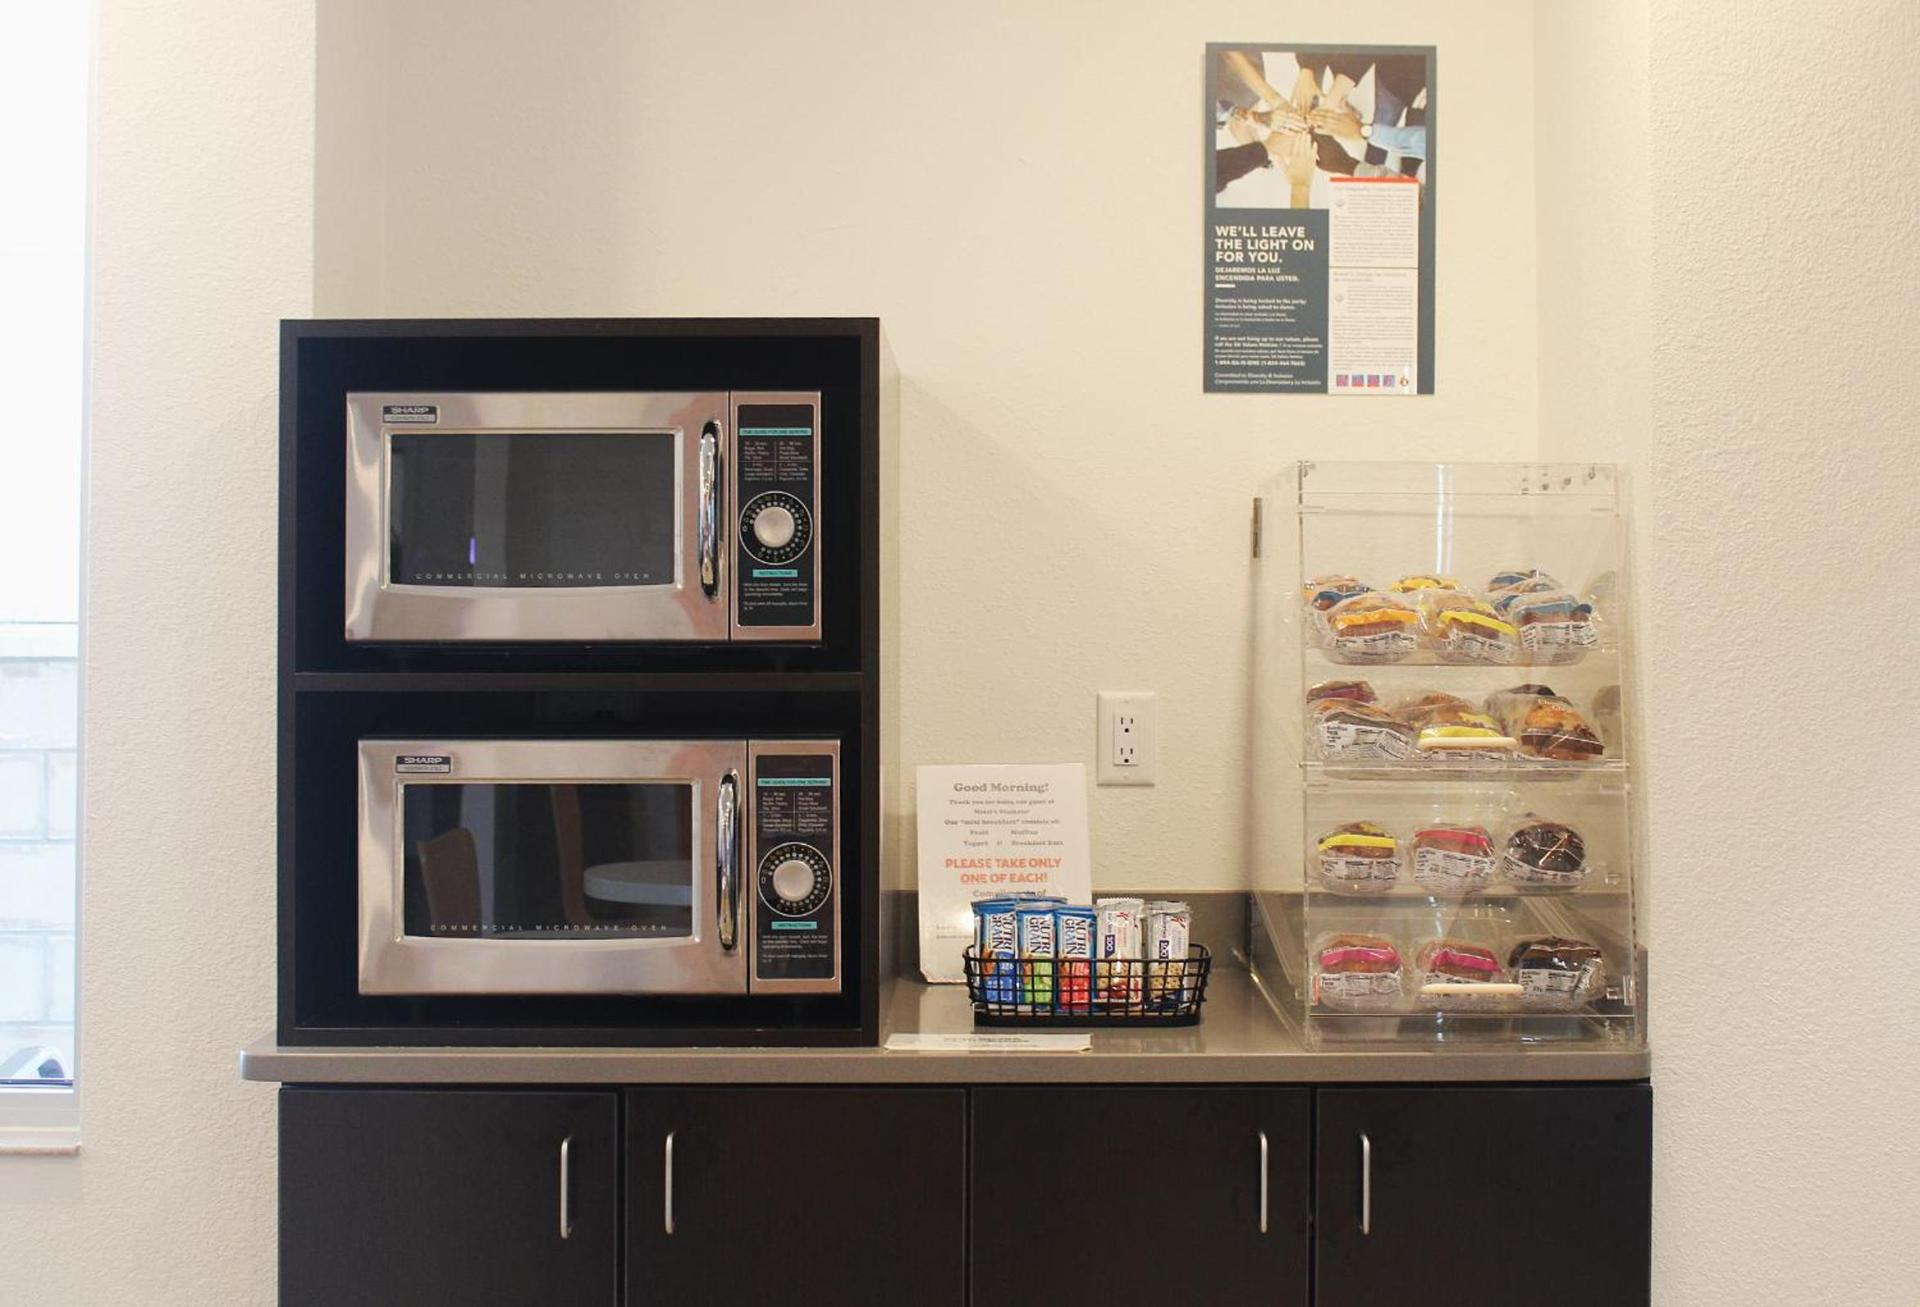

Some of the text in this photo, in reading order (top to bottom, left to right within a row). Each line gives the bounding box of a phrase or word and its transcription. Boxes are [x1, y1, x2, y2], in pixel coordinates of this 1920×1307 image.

[1215, 225, 1305, 238] WE'LL LEAVE
[1215, 239, 1314, 251] THE LIGHT ON
[1215, 251, 1283, 263] FOR YOU.
[953, 783, 1049, 794] Good Morning!
[945, 857, 1062, 869] PLEASE TAKE ONLY
[960, 872, 1048, 884] ONE OF EACH!
[1001, 913, 1016, 951] NUTRI
[1029, 917, 1040, 954] GRAIN
[1039, 916, 1051, 954] NUTRI
[1065, 918, 1076, 955] GRAIN
[1075, 919, 1087, 955] NUTRI
